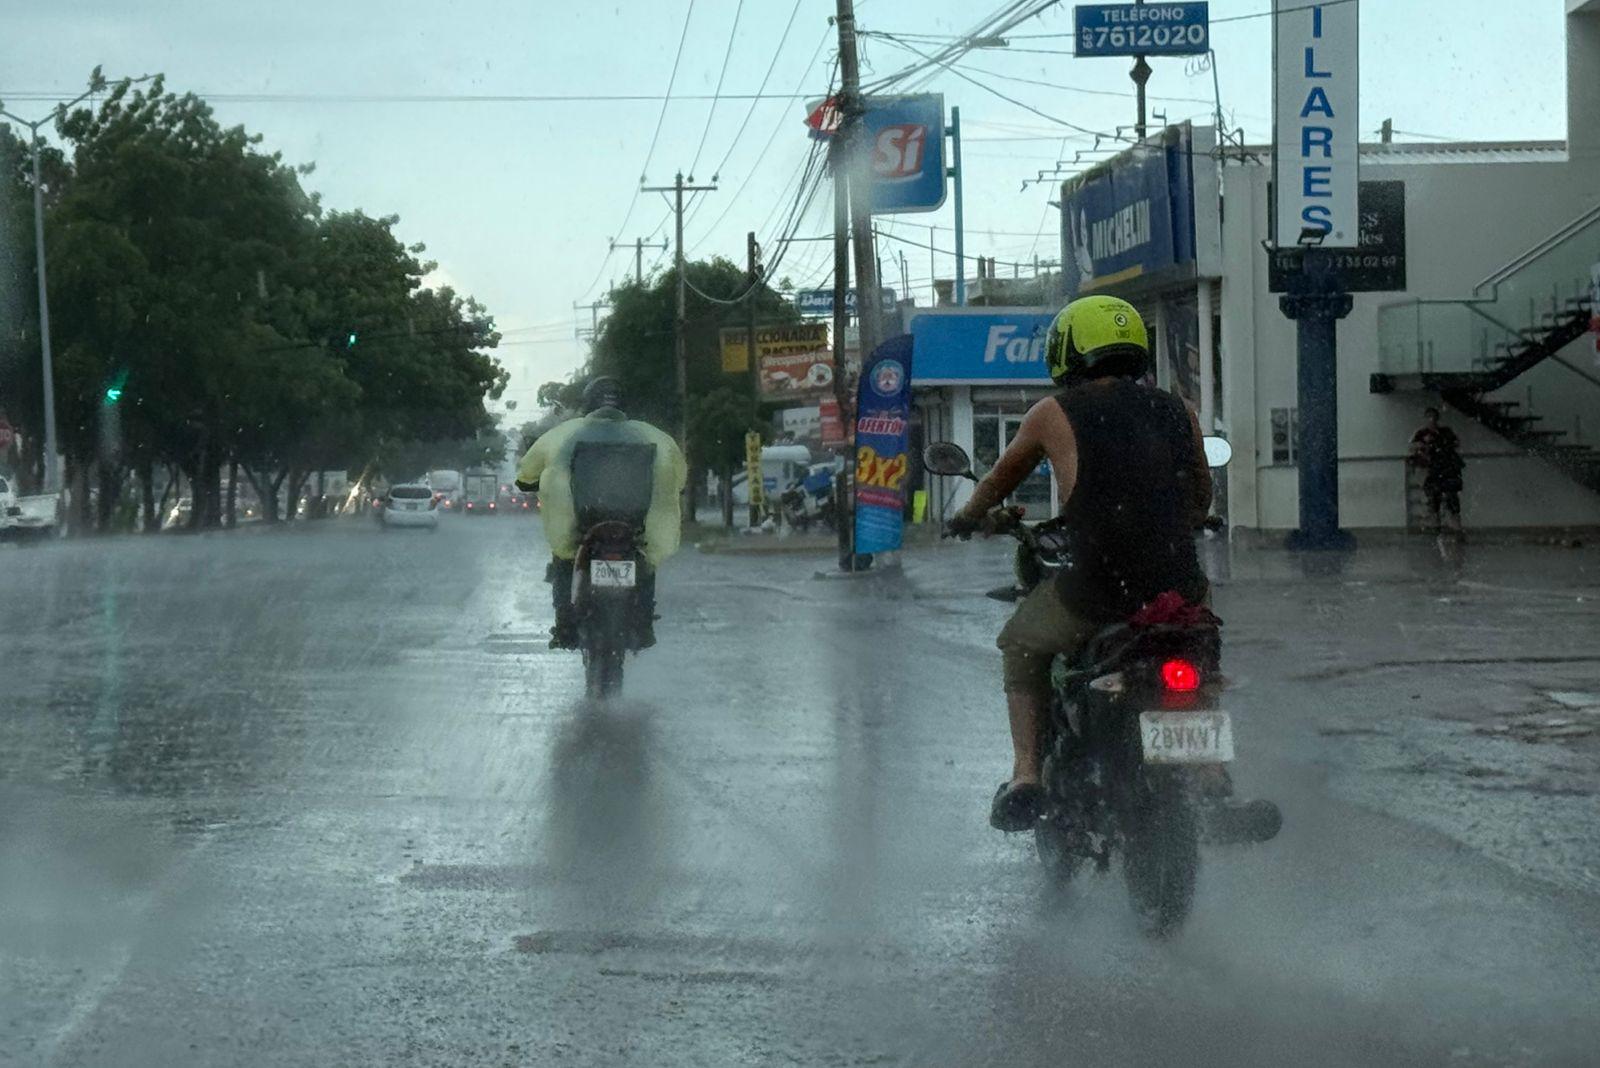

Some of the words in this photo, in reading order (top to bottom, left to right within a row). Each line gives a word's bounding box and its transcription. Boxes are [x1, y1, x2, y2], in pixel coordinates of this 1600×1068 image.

[1102, 6, 1185, 22] TELÉFONO
[1095, 24, 1205, 47] 7612020
[1301, 5, 1334, 235] ILARES
[1092, 198, 1150, 260] MICHELIN
[801, 293, 835, 307] Dair
[984, 325, 1046, 363] Far
